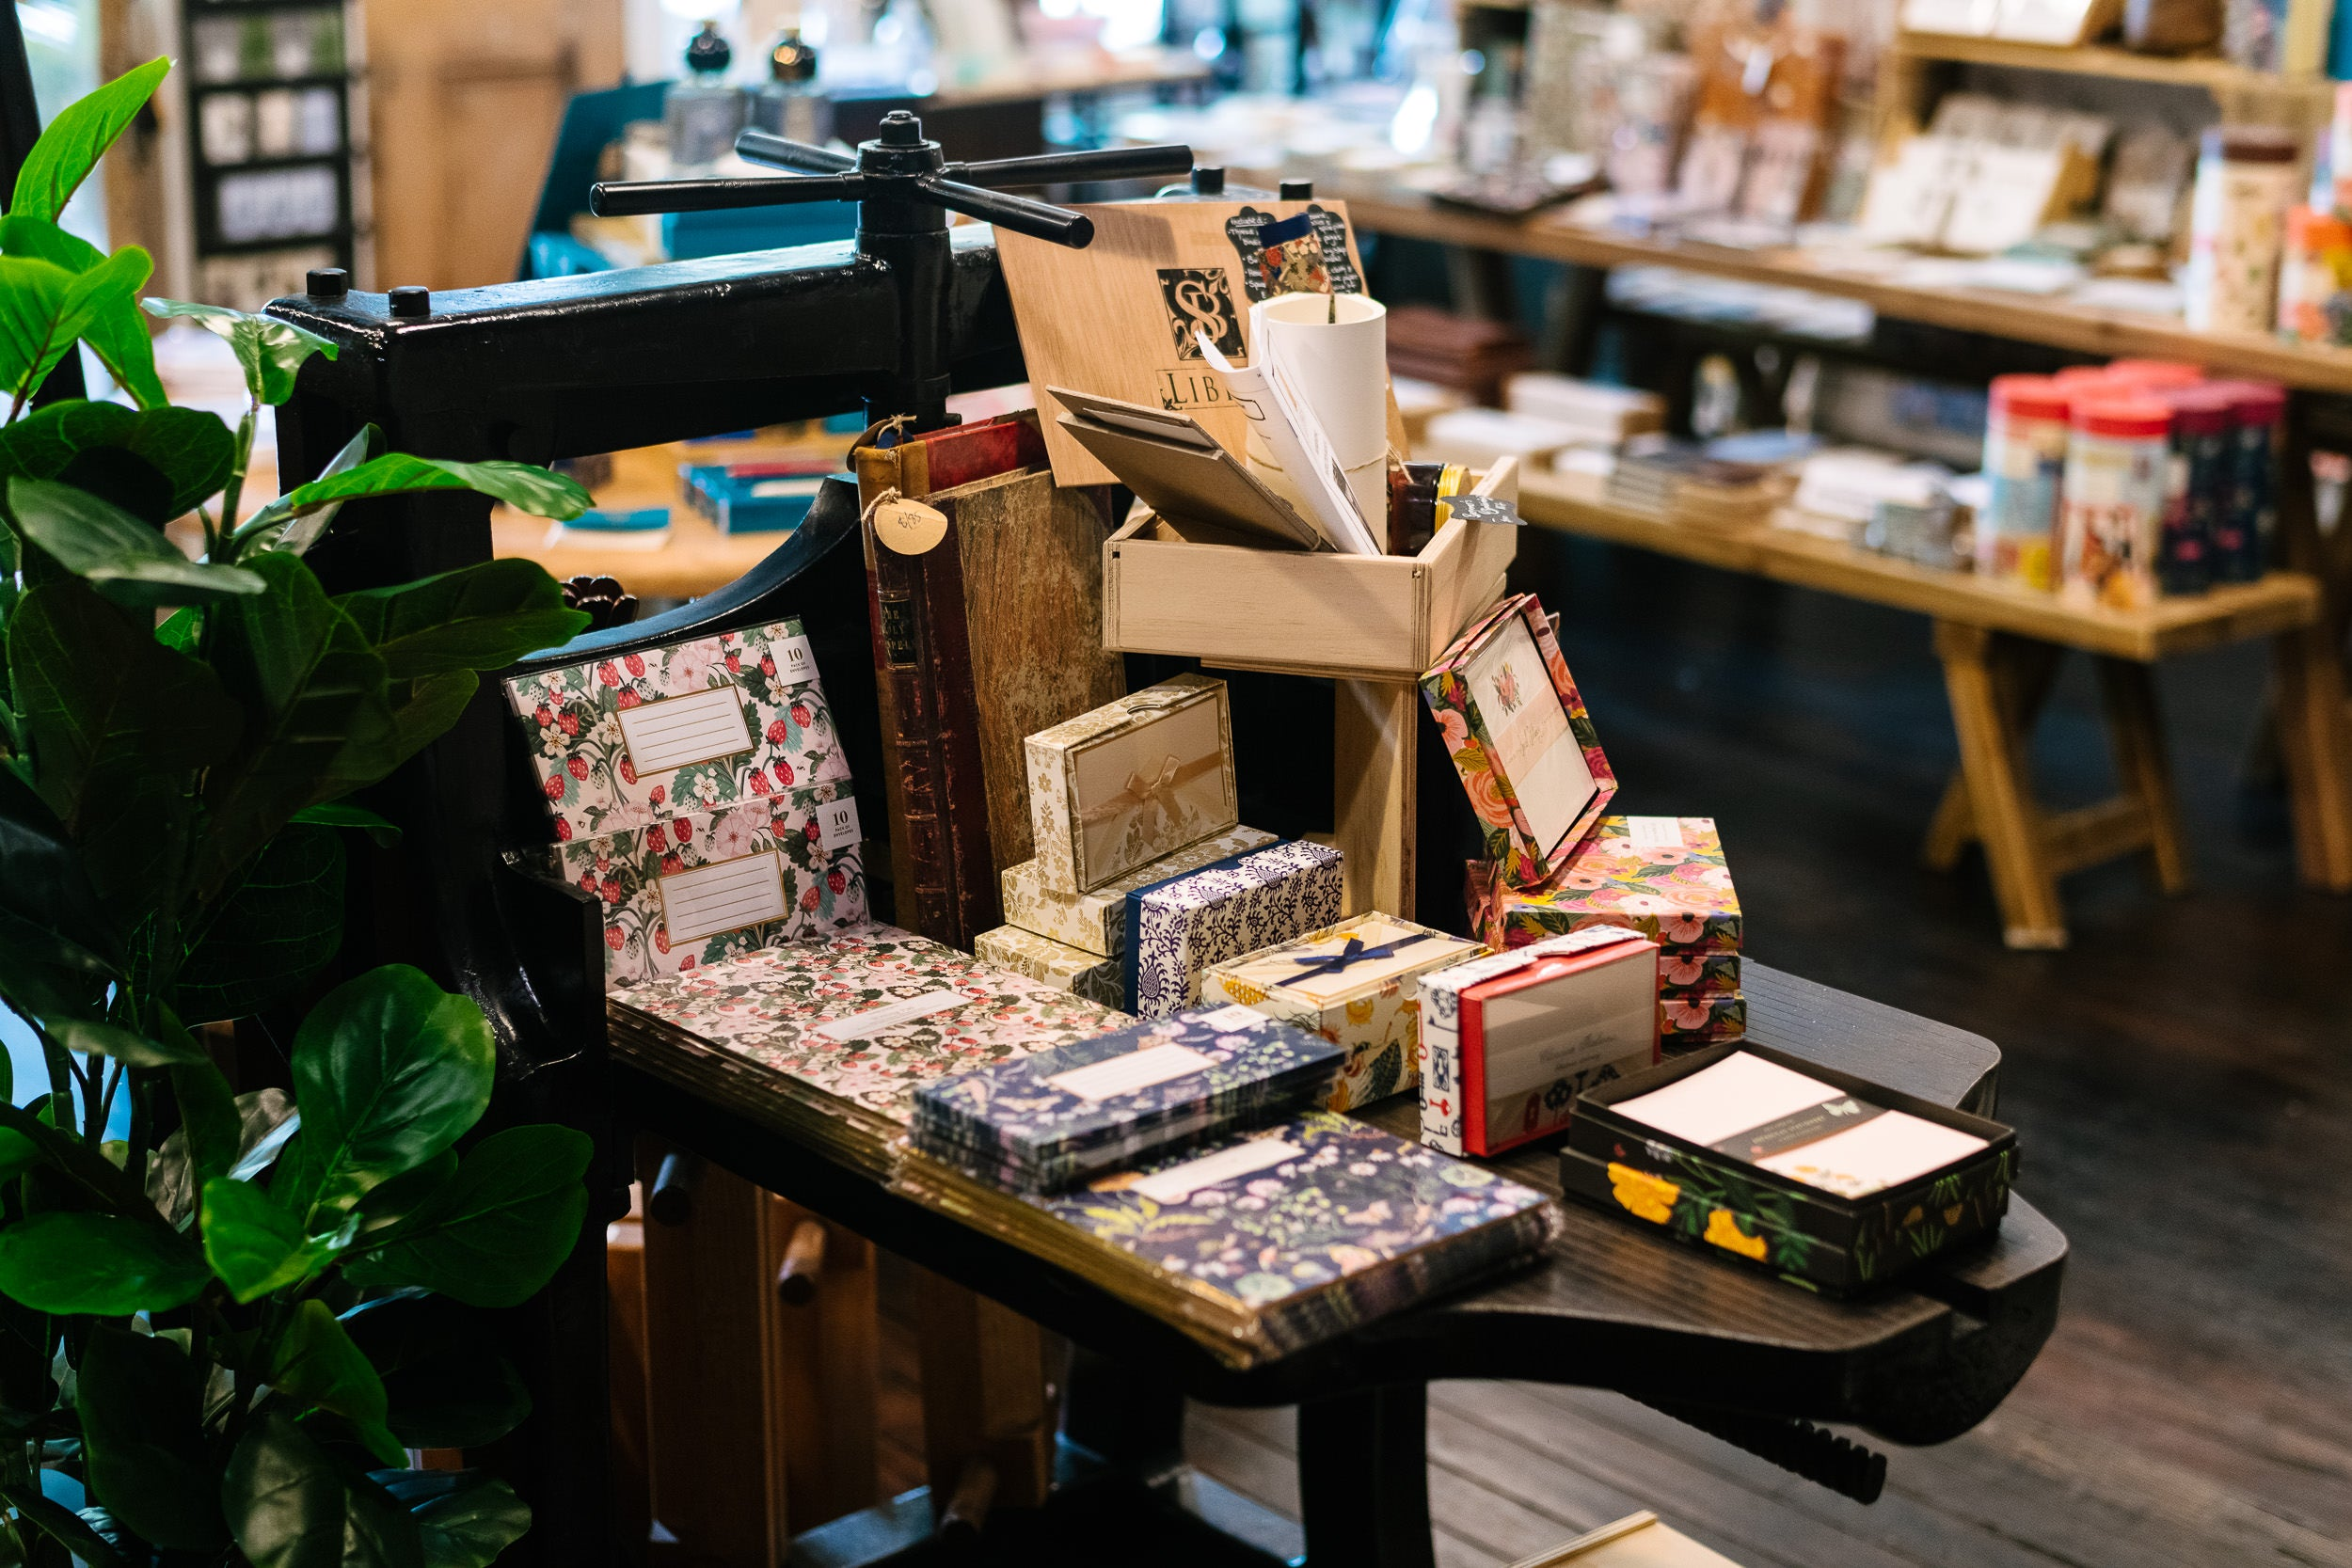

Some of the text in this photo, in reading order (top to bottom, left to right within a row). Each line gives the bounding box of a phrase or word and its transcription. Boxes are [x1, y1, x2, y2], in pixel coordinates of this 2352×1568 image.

[787, 647, 803, 662] 10
[833, 810, 849, 826] 10
[833, 829, 854, 838] ENVELOPES
